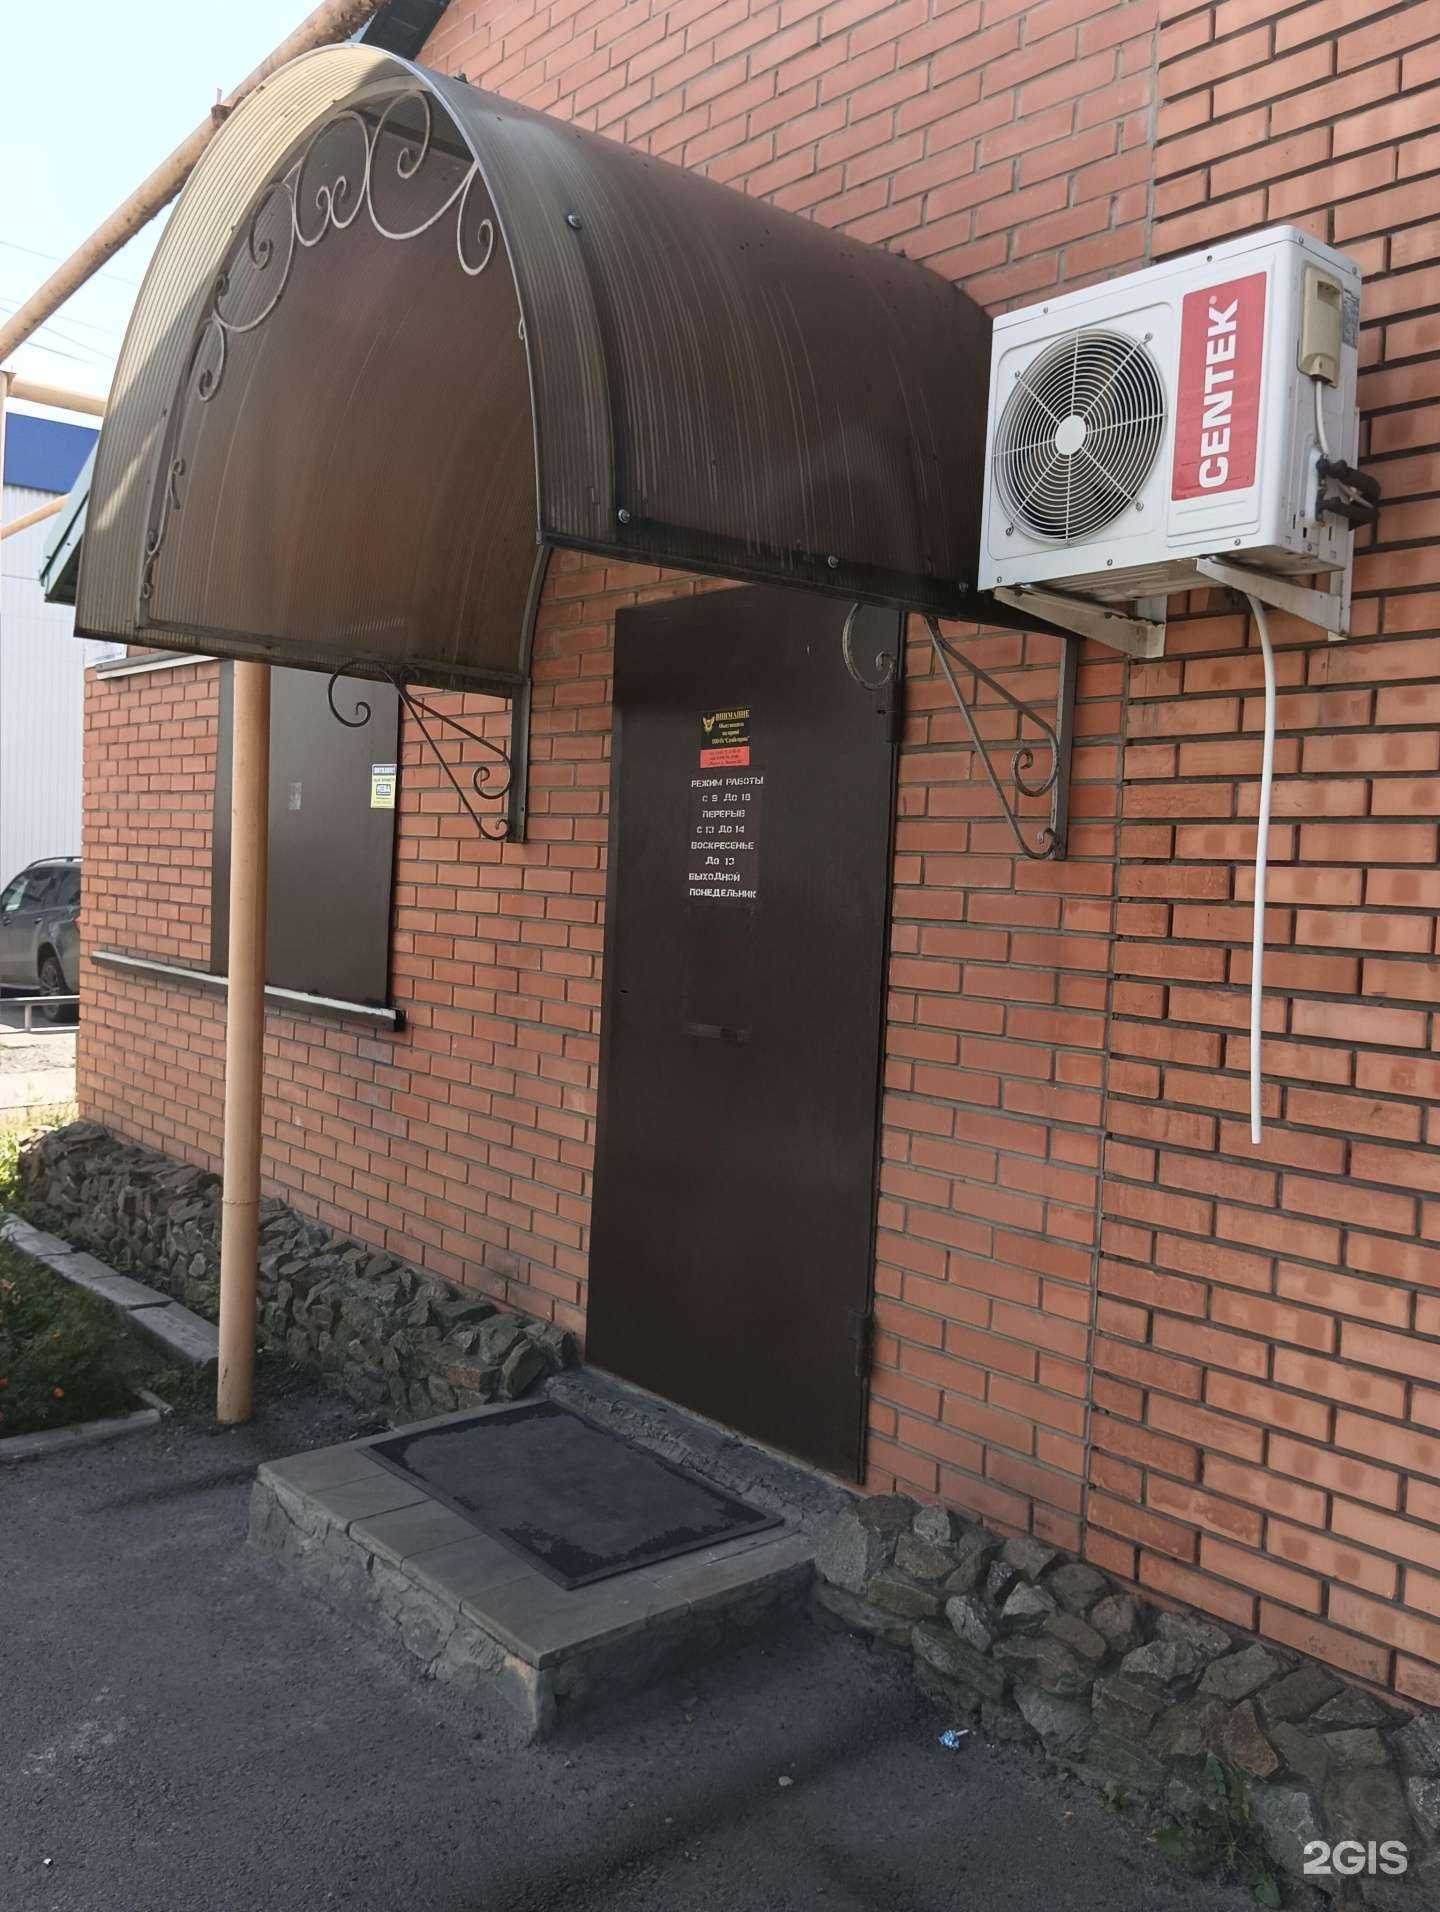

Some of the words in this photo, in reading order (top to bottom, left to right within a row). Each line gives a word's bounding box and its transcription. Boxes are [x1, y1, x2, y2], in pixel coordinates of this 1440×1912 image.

[1199, 298, 1239, 488] CENTEK
[691, 779, 722, 788] РЕЖИМ
[725, 776, 764, 786] РАБОТЫ
[702, 809, 746, 818] ПЕРЕРЫВ
[735, 825, 745, 834] 14
[690, 841, 755, 850] ВОСКРЕСЕНЬЕ
[689, 888, 757, 898] ПОНЕДЕЛЬНИК
